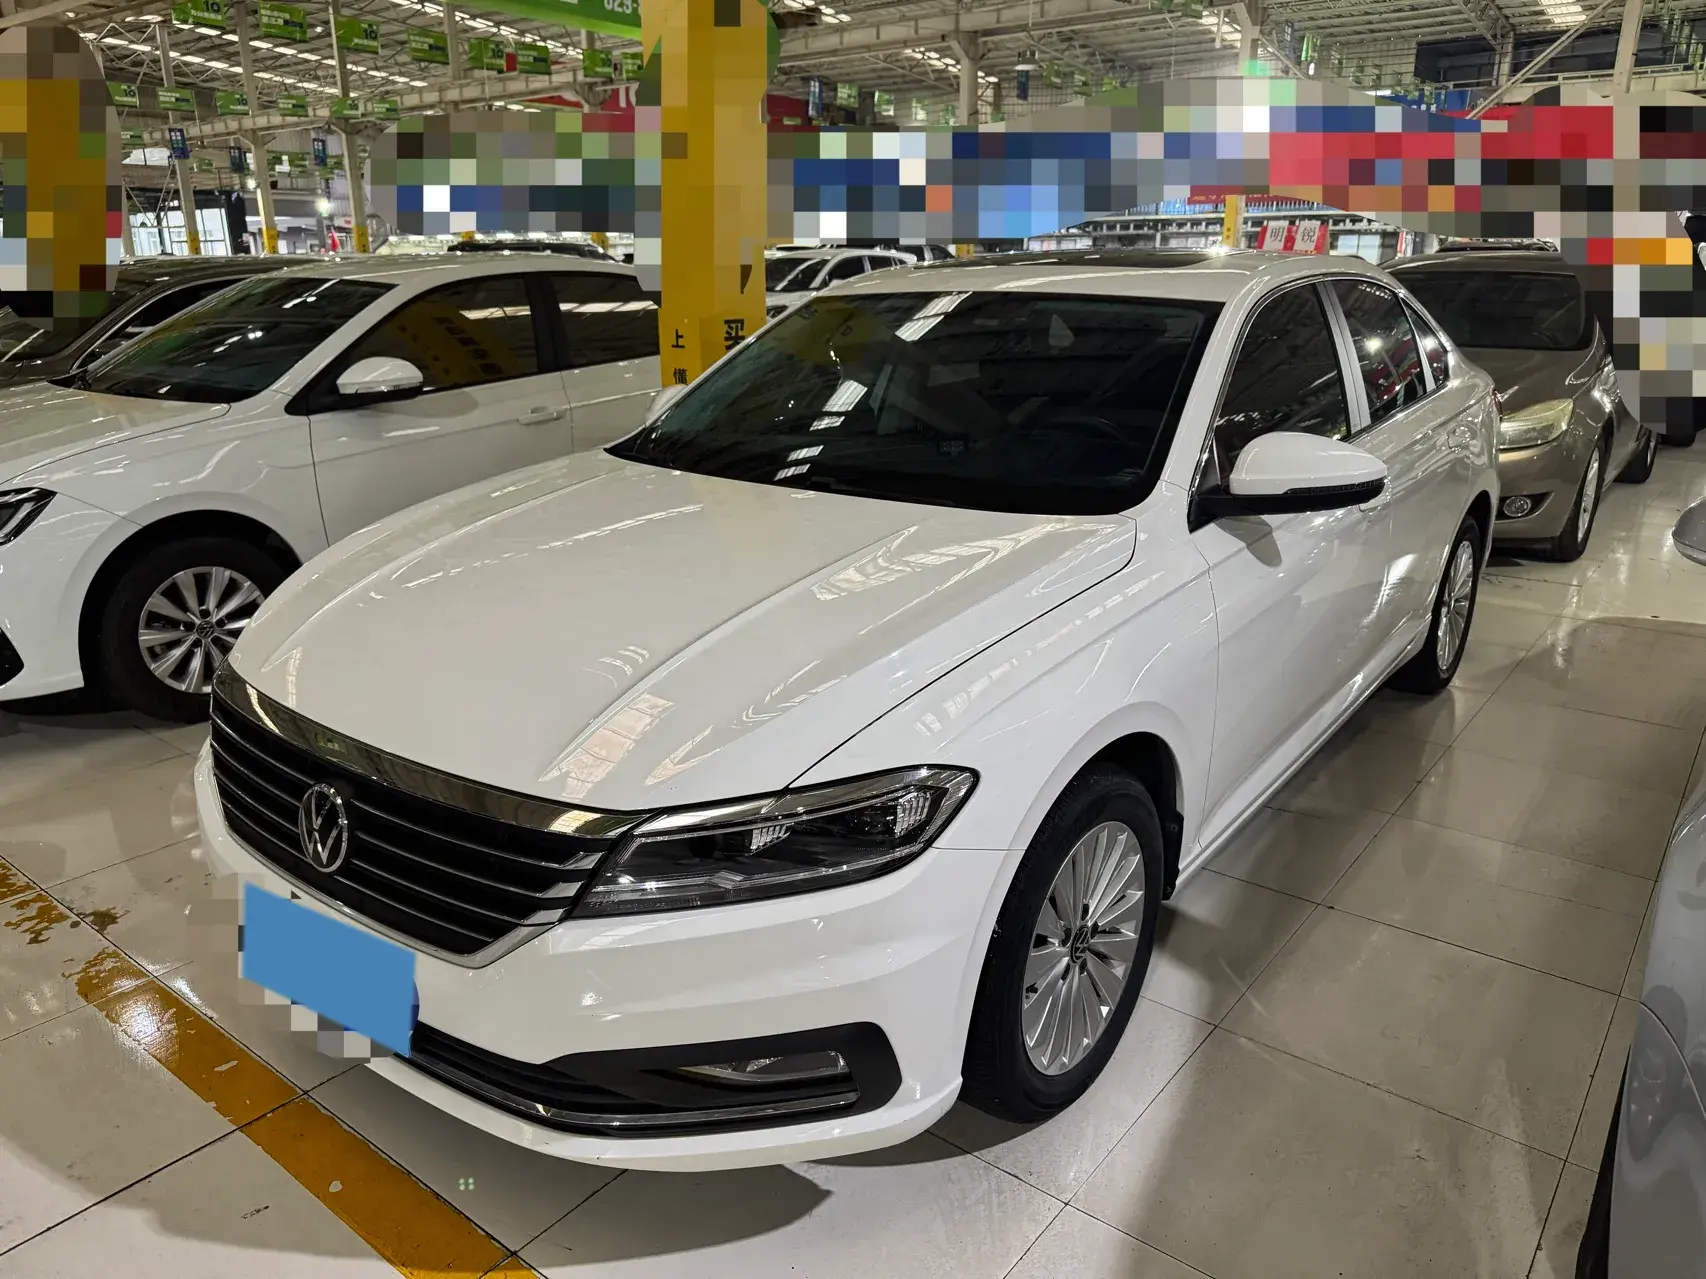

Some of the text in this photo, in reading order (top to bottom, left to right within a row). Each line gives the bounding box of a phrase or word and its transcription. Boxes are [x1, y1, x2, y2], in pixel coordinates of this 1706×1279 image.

[203, 0, 221, 13] 10
[363, 28, 378, 40] 10
[123, 89, 136, 97] 10
[1269, 226, 1317, 243] 明锐
[724, 319, 746, 351] 买
